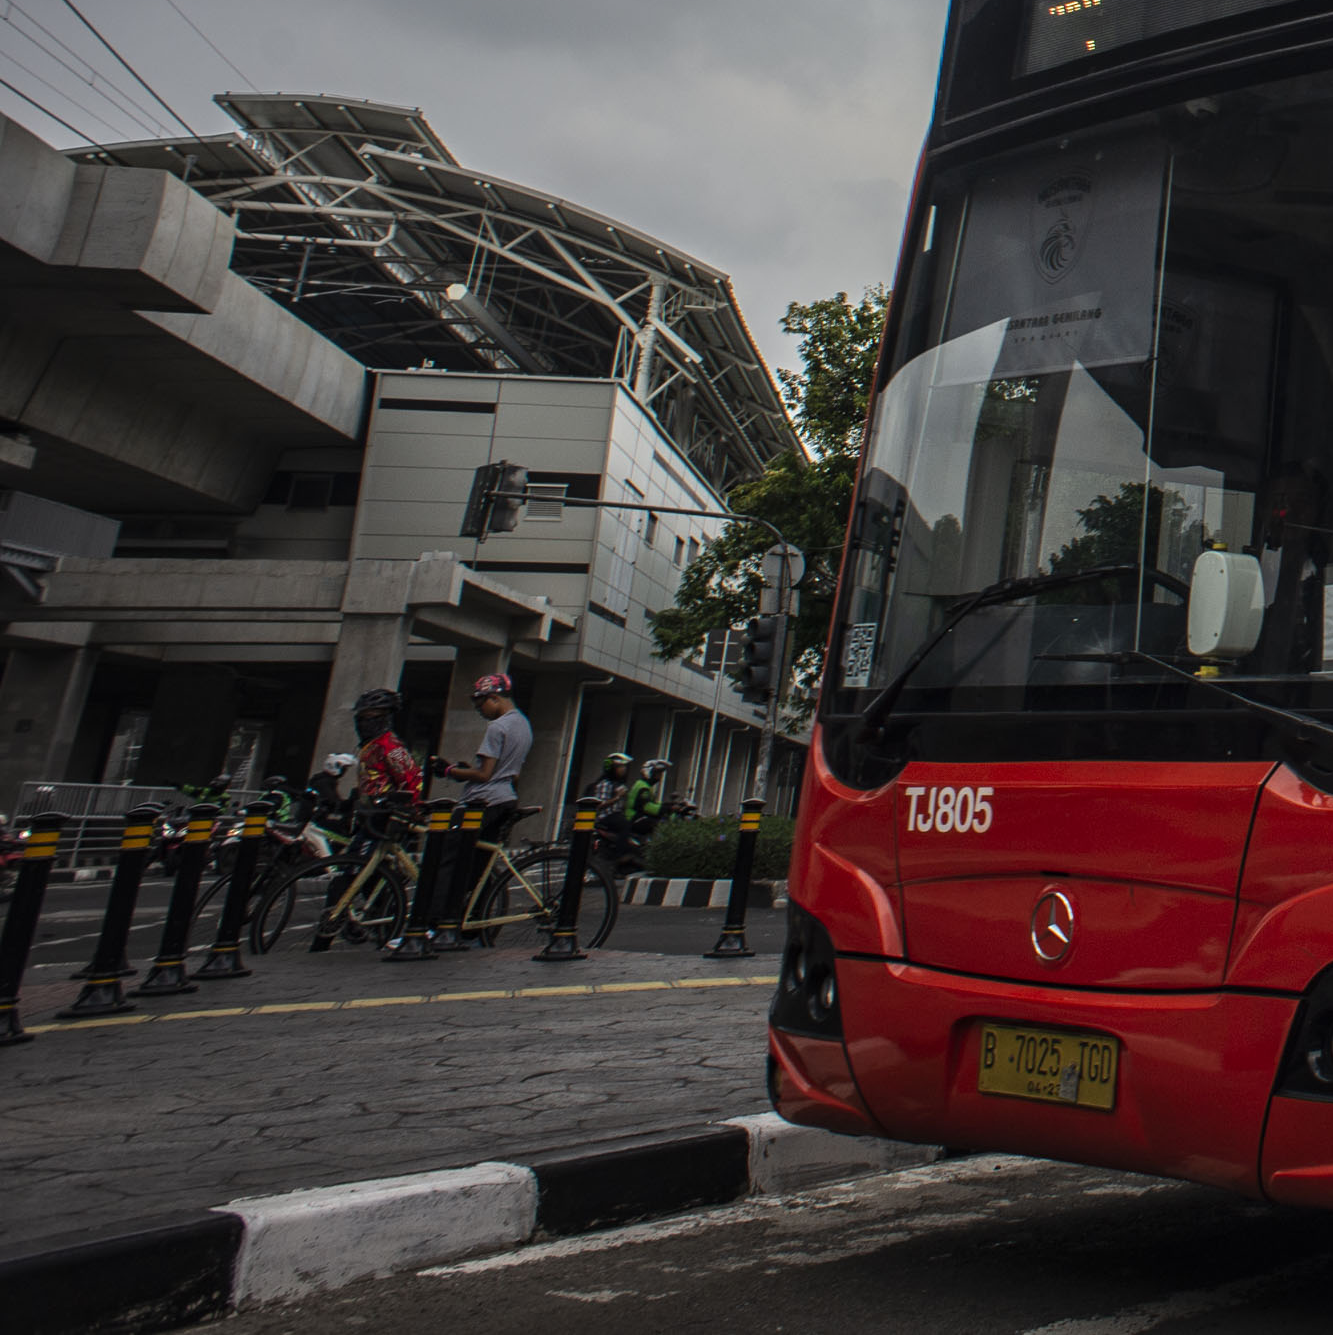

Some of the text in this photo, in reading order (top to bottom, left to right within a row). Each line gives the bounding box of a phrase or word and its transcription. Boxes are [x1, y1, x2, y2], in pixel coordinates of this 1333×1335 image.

[904, 786, 995, 833] TJ805
[984, 1031, 1112, 1084] B 7025 TGD
